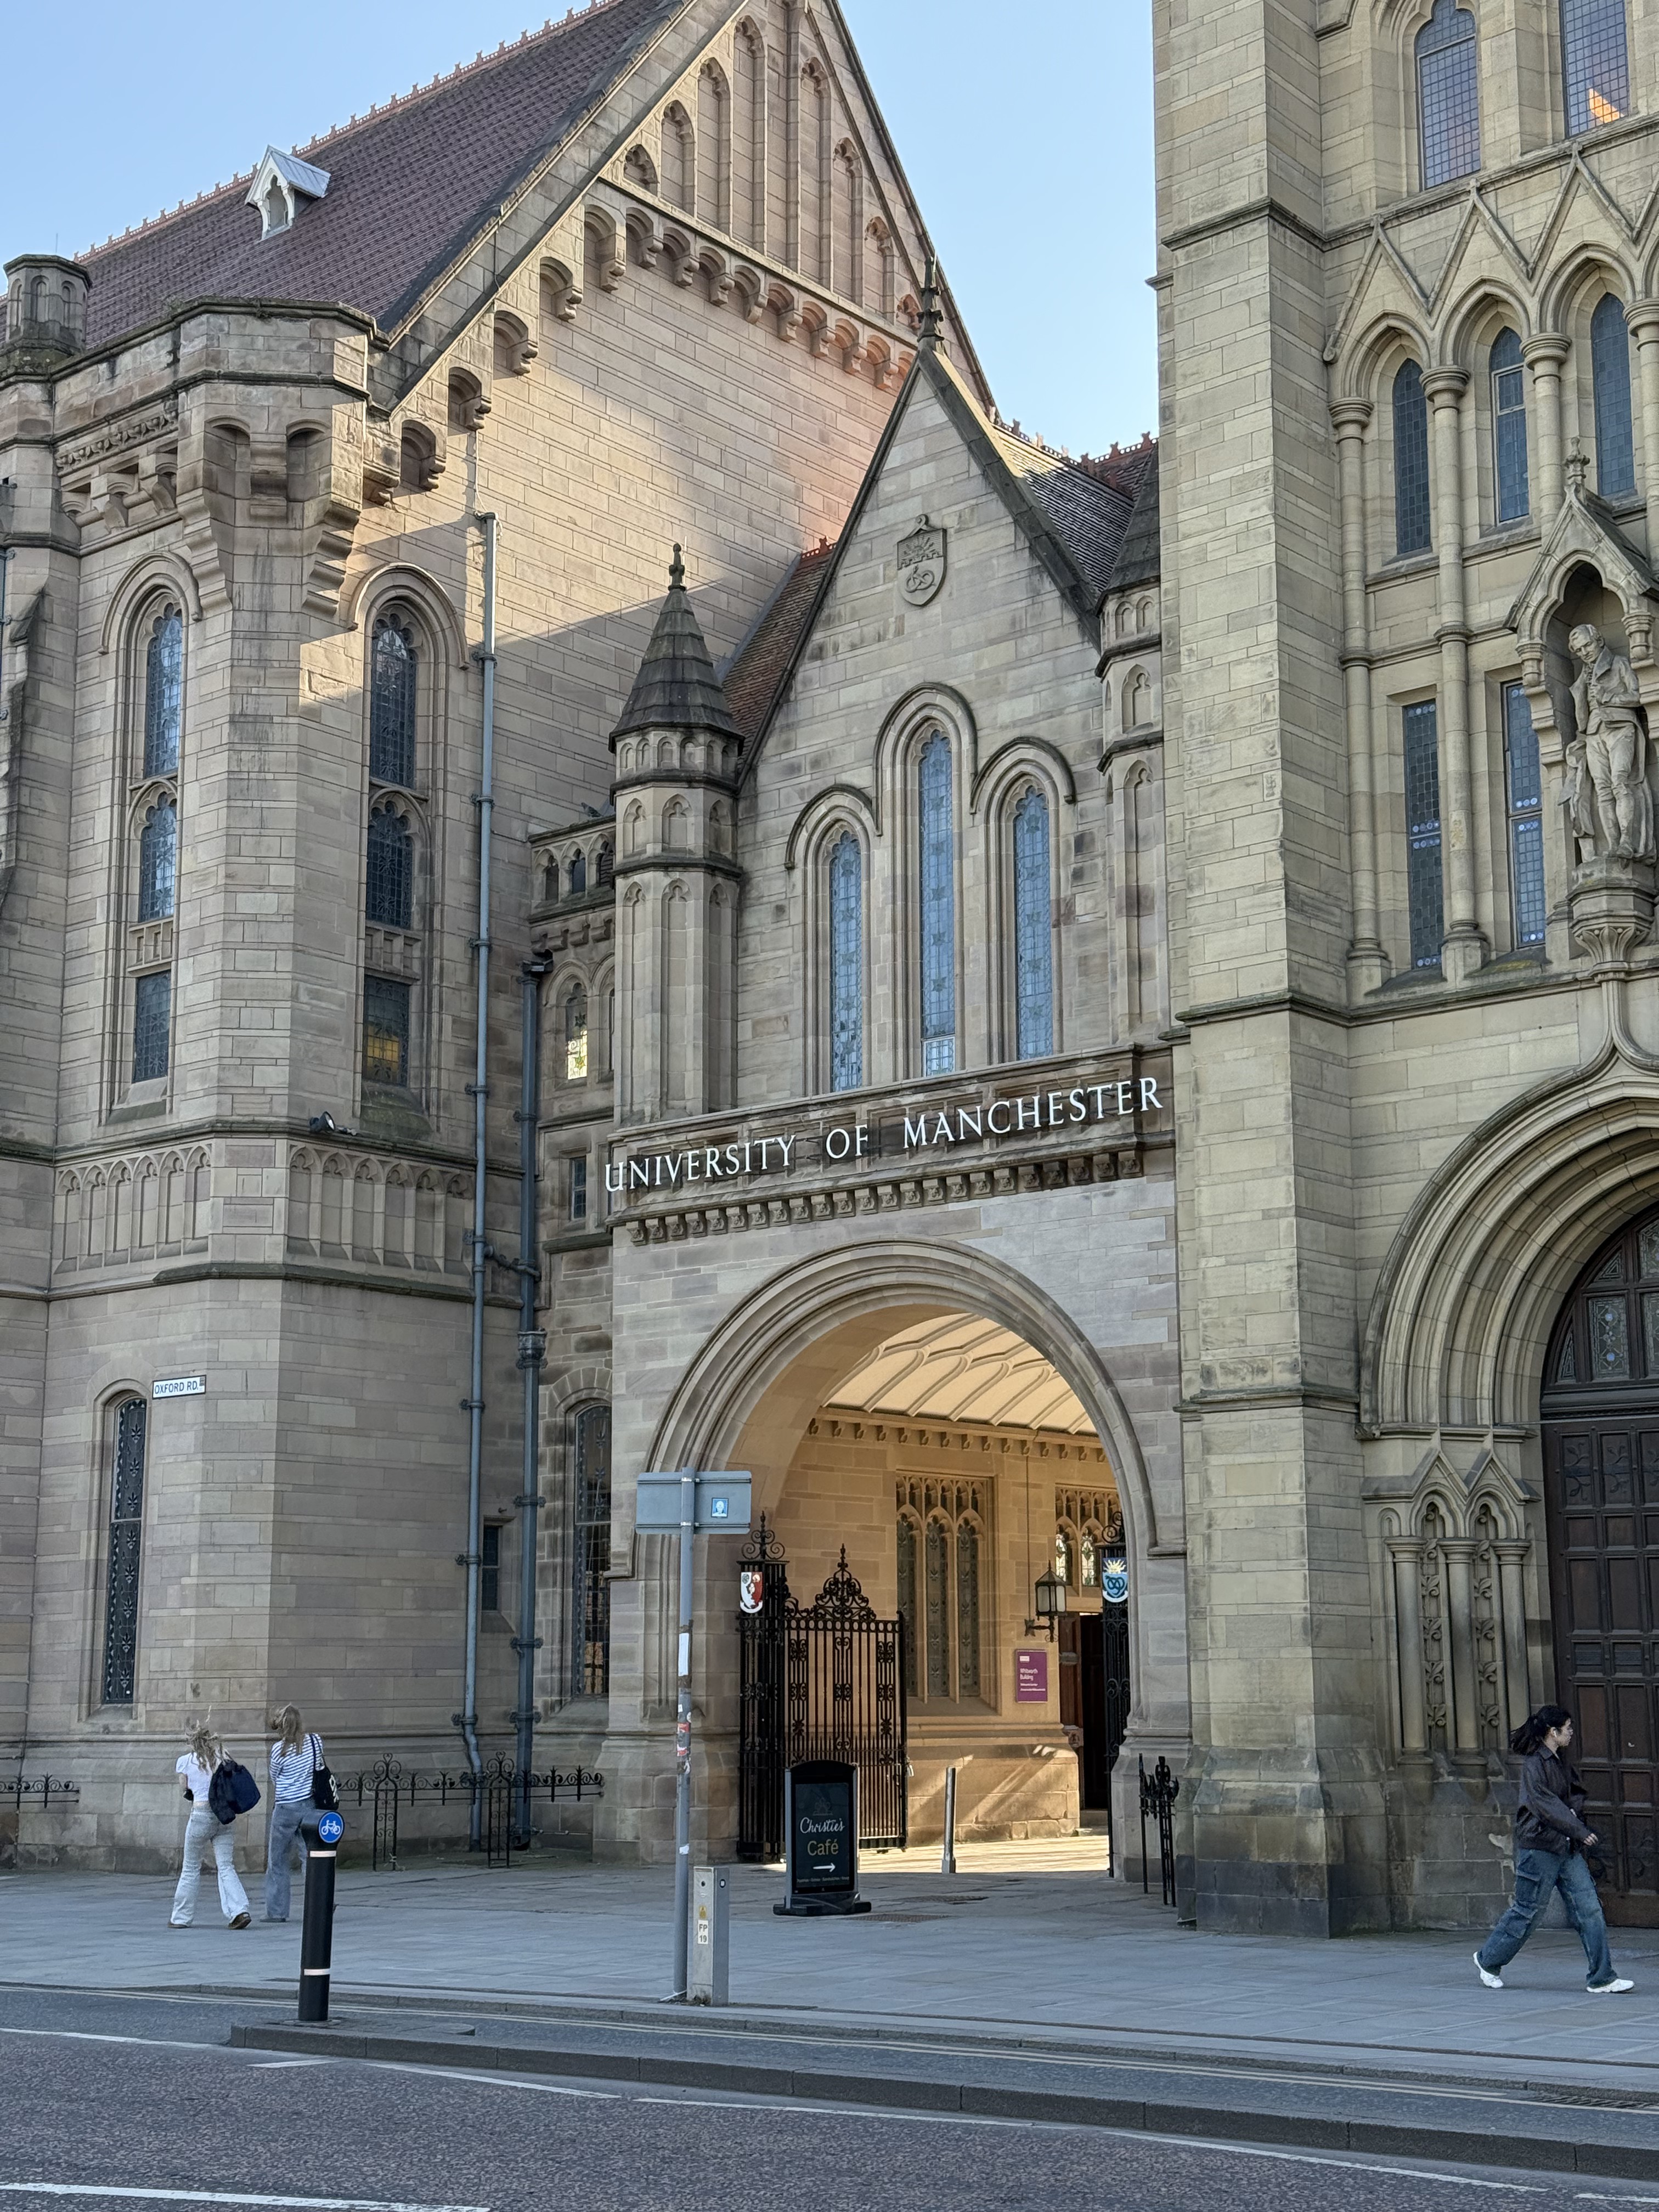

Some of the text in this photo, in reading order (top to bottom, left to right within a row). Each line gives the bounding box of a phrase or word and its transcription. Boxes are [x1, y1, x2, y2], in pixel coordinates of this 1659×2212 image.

[605, 1076, 1164, 1193] UNIVERSITY OF MANCHESTER
[154, 1382, 184, 1394] OXFORD
[800, 1816, 845, 1833] Christie's
[807, 1838, 839, 1856] Café
[699, 1923, 708, 1932] FP
[699, 1934, 707, 1943] 19
